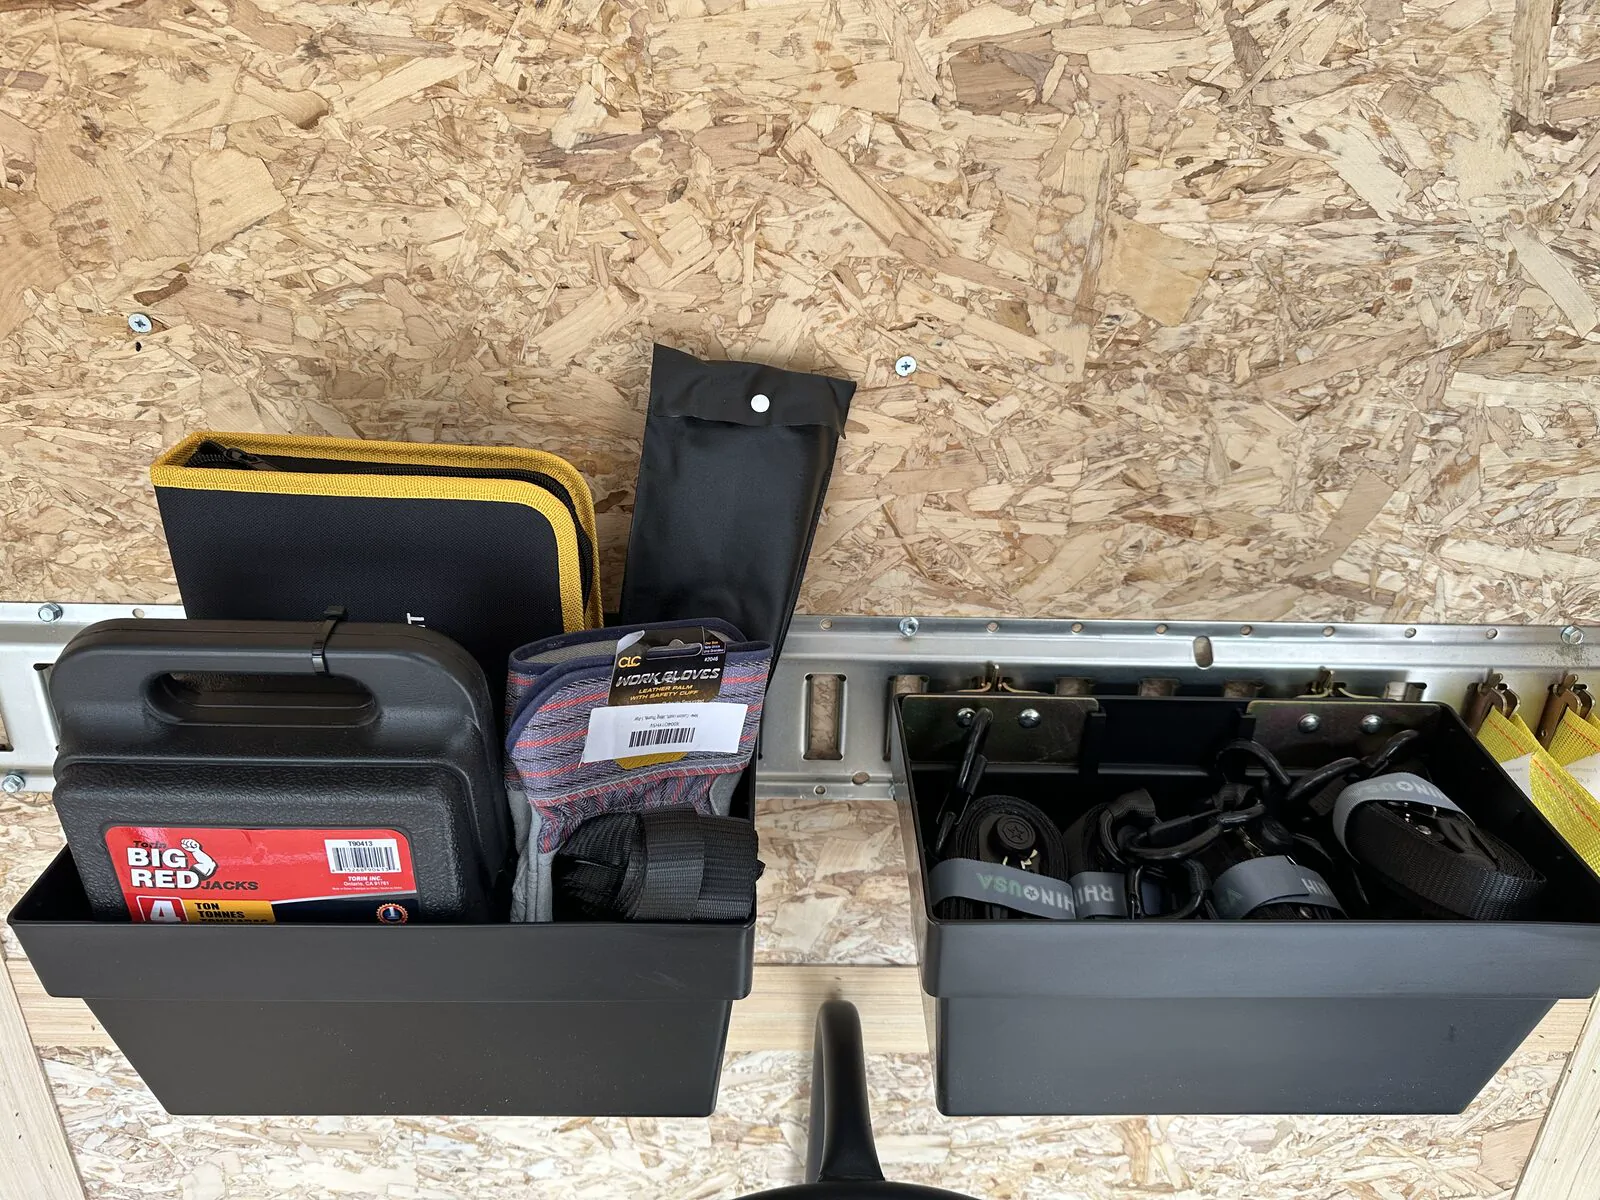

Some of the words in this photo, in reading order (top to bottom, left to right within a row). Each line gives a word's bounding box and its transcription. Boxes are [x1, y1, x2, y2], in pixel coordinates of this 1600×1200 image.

[618, 656, 642, 668] CLC
[616, 672, 660, 687] WORK
[660, 668, 721, 685] GLOVES
[638, 685, 671, 693] LEATHER
[629, 693, 648, 701] WITH
[649, 691, 678, 699] SAFETY
[133, 840, 167, 849] Torin
[126, 847, 187, 868] BIG
[130, 869, 200, 889] RED
[201, 881, 259, 891] JACKS
[150, 900, 181, 922] 4
[194, 902, 219, 910] TON
[196, 911, 246, 919] TONNES
